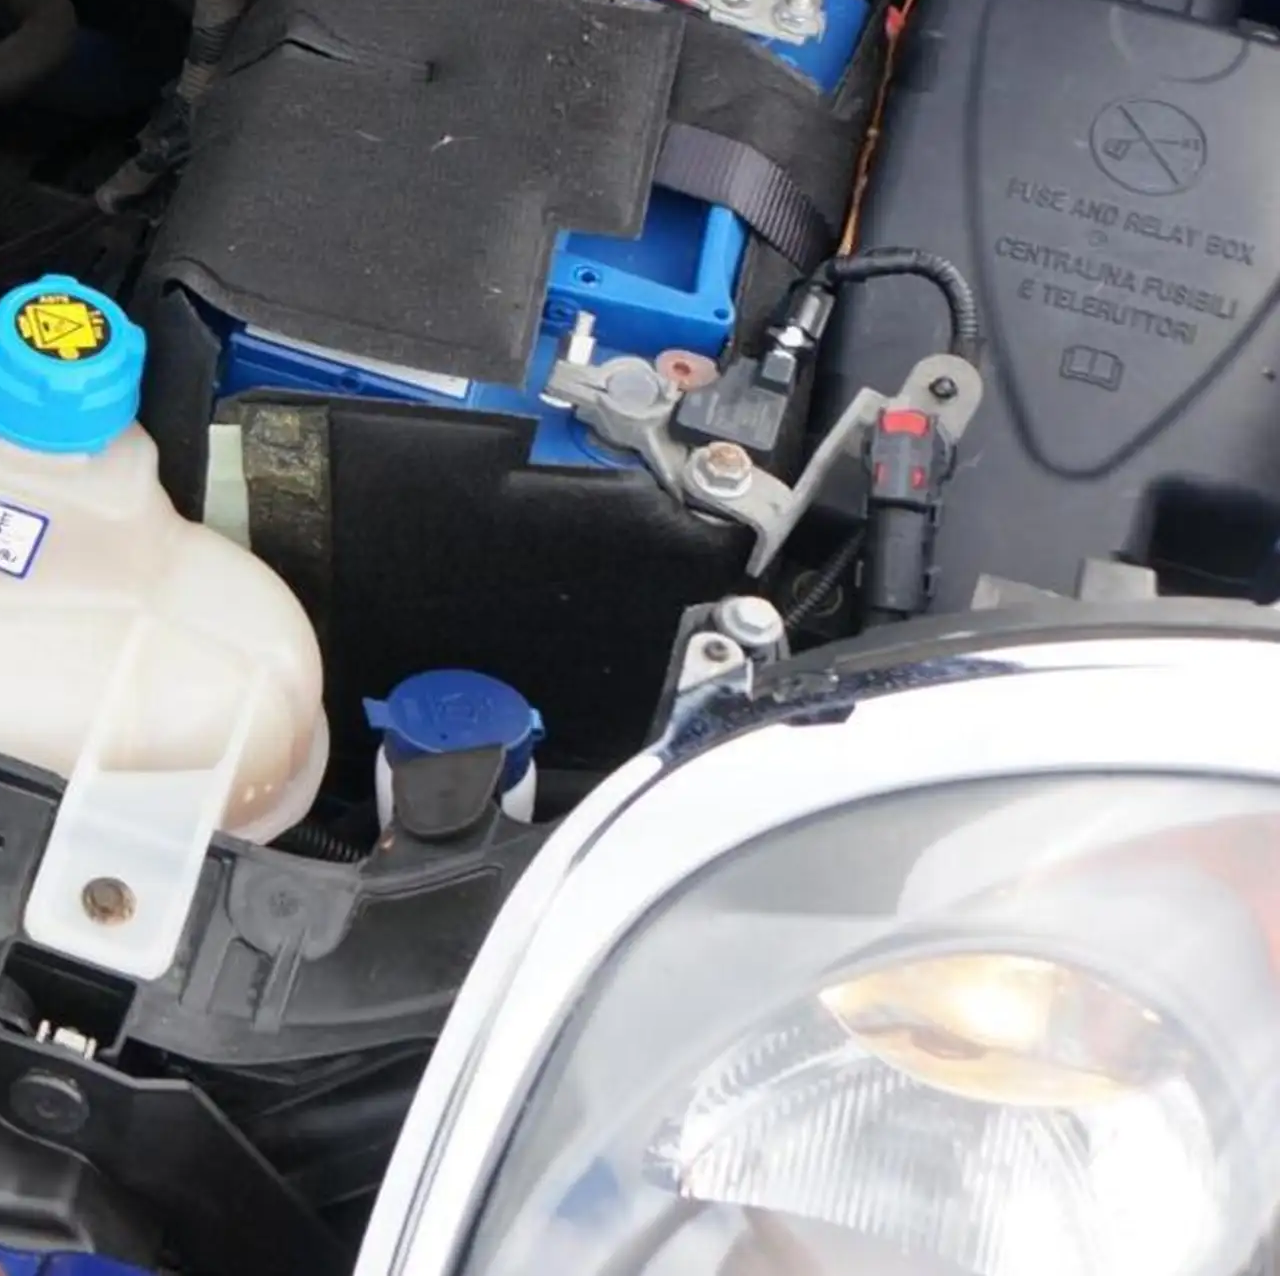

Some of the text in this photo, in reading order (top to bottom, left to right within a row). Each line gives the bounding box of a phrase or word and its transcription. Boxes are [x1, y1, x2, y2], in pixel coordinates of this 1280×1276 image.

[1005, 177, 1071, 212] FUSE
[1068, 197, 1121, 226] AND
[1204, 233, 1256, 266] BOX
[993, 235, 1137, 293] CENTRALINA
[1017, 278, 1199, 345] E TELERUTTORI
